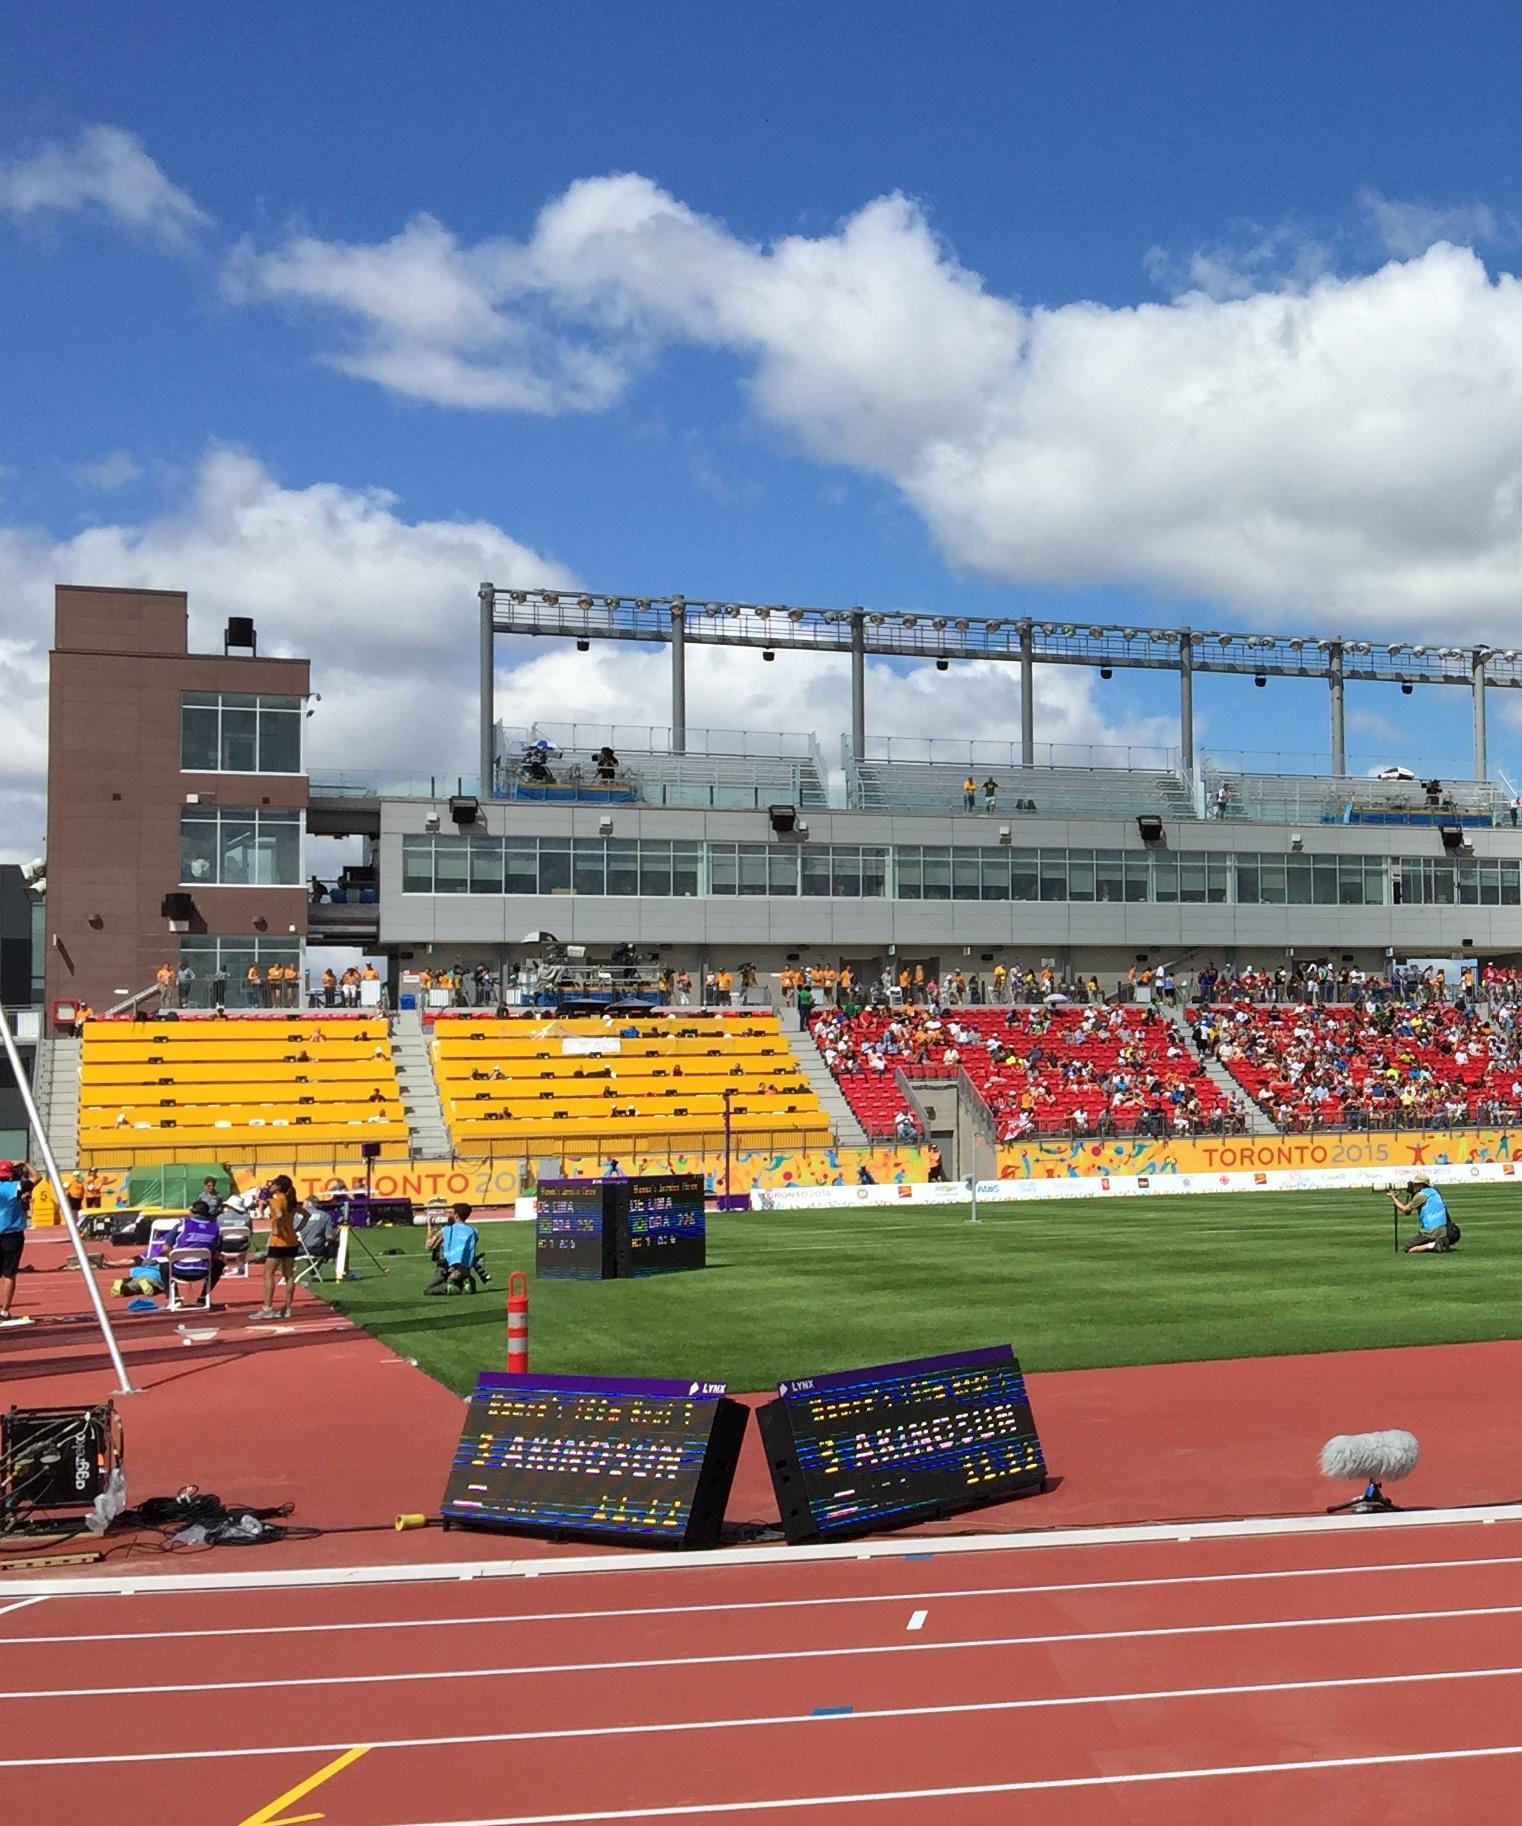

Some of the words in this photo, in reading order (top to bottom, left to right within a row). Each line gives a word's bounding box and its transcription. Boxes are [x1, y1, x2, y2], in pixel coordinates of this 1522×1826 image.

[1204, 1145, 1328, 1168] TORONTO
[1331, 1143, 1389, 1163] 2015
[40, 1190, 48, 1201] 5
[702, 1382, 727, 1394] LYNX
[791, 1380, 815, 1392] LYNX
